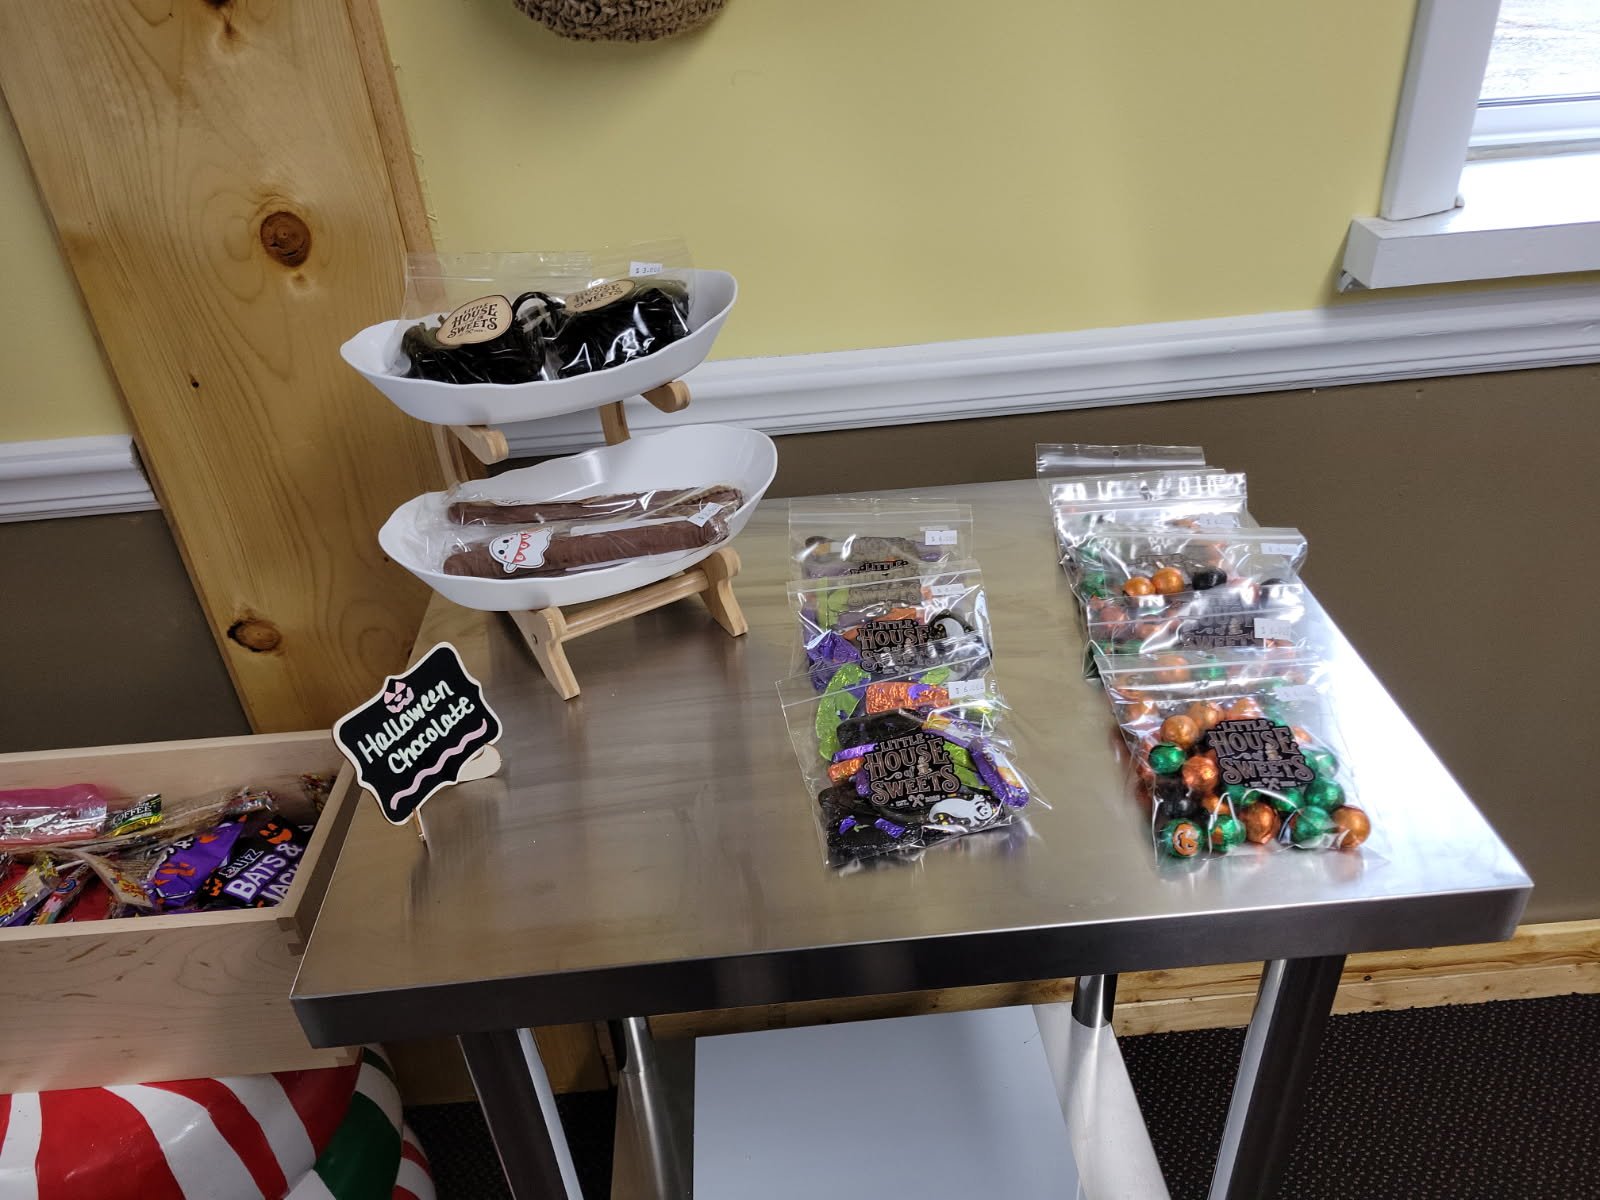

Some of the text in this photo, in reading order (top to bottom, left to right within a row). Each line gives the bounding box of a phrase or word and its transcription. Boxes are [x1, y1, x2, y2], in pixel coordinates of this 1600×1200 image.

[447, 317, 498, 339] SWEETS
[452, 303, 498, 328] HOUSE
[857, 625, 930, 650] HOUSE
[871, 619, 913, 630] LITTLE
[357, 680, 455, 764] Halloween
[387, 696, 475, 774] Chocolate
[1220, 719, 1270, 732] LITTLE
[879, 732, 926, 752] LITTLE
[1207, 727, 1303, 758] HOUSE
[864, 736, 951, 781] HOUSE
[1219, 755, 1314, 785] SWEETS
[870, 764, 960, 805] SWEETS
[225, 842, 303, 900] BATS &
